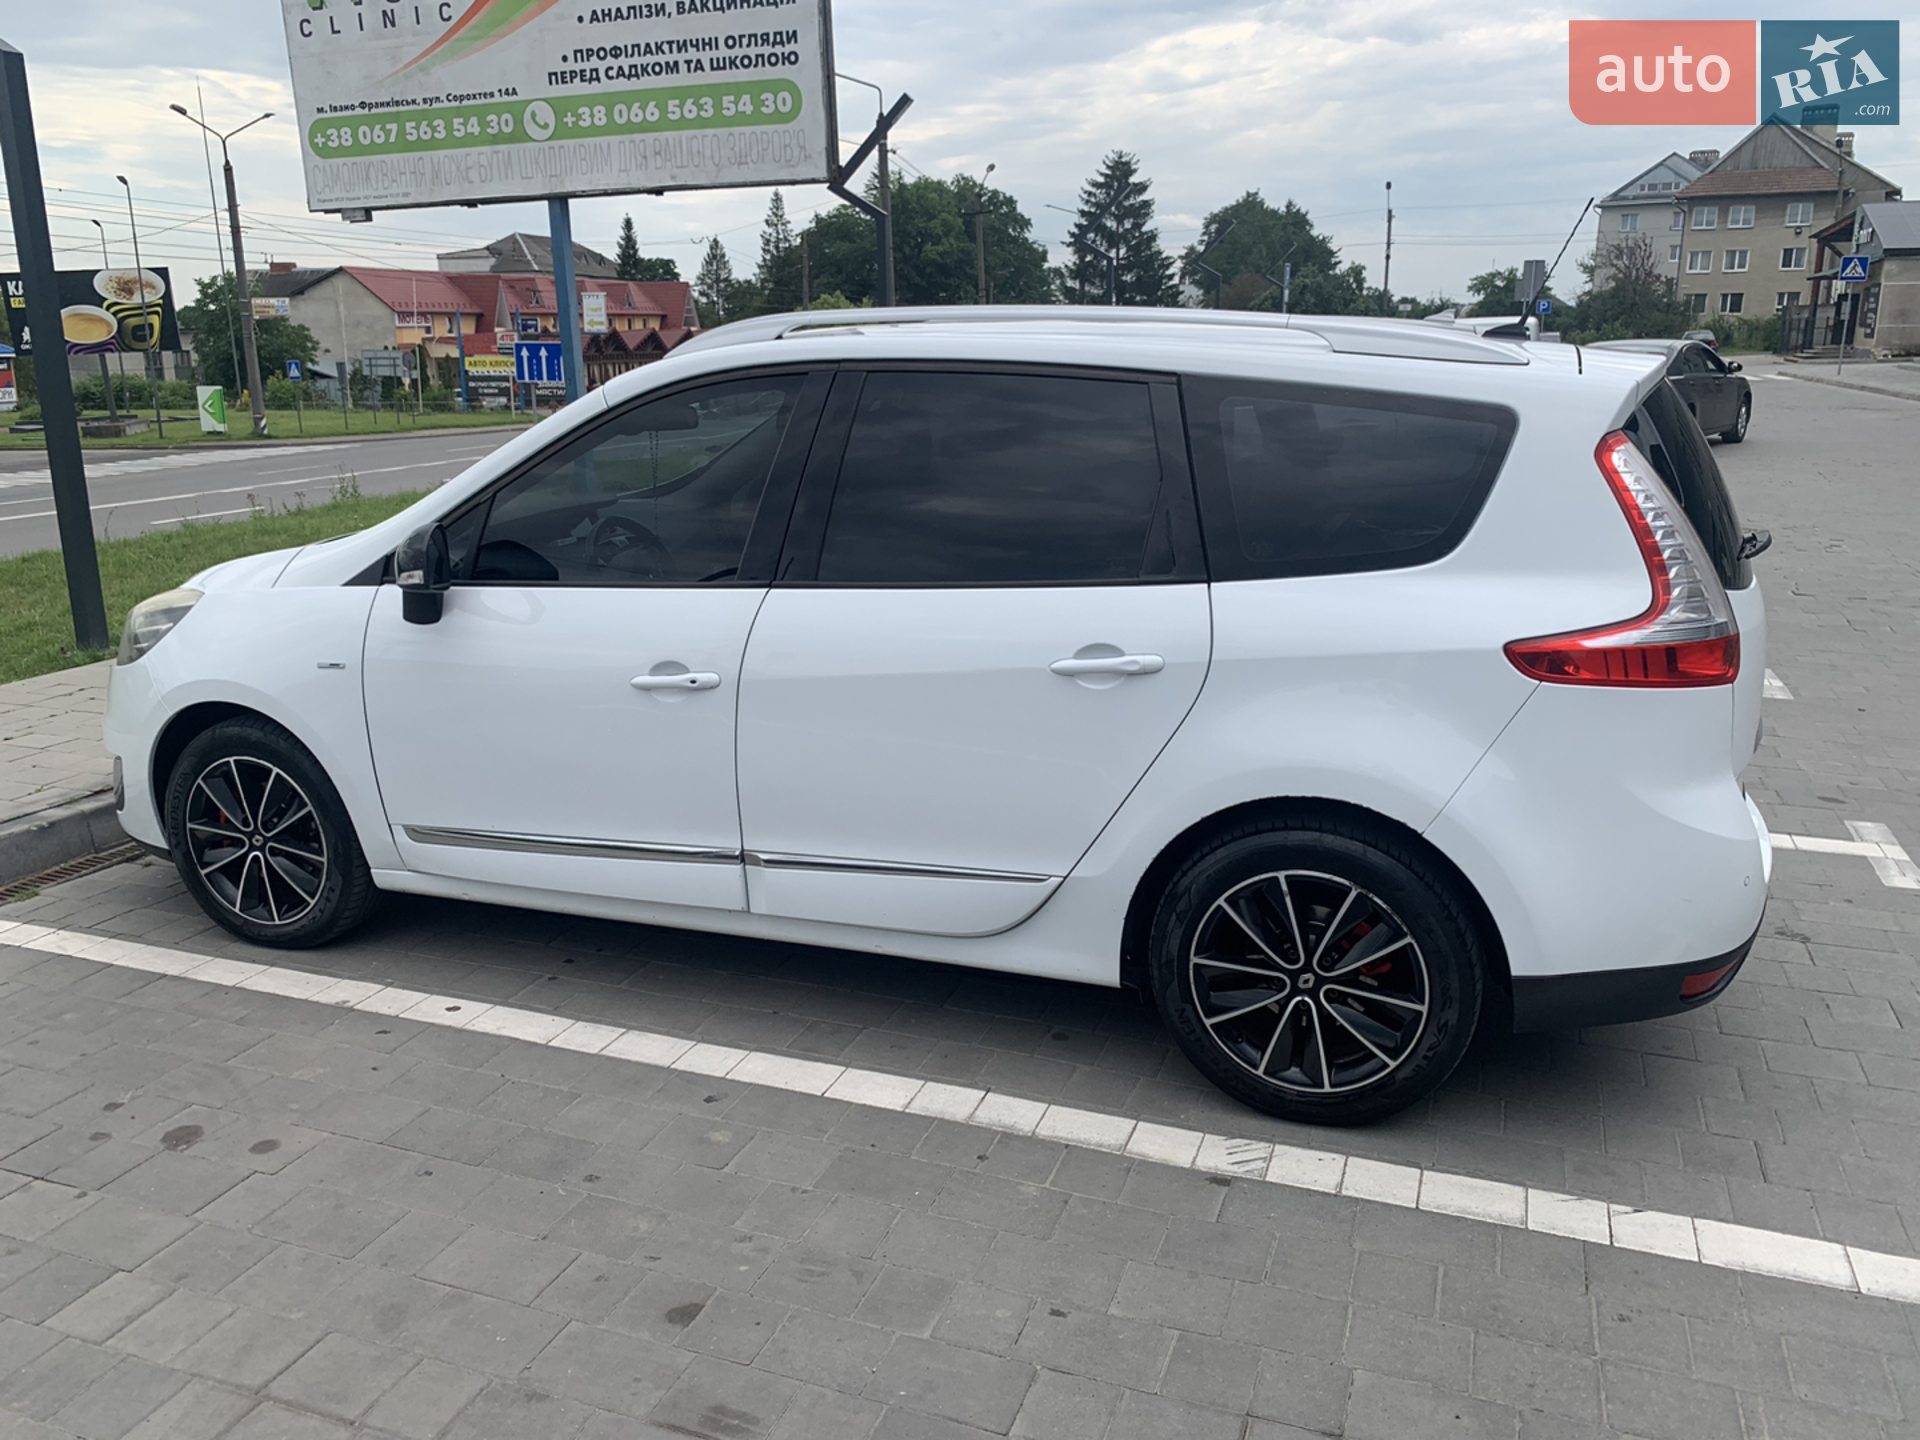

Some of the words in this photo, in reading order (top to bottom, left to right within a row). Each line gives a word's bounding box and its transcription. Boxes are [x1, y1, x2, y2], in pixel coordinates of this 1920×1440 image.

[299, 2, 453, 38] CLINIC
[589, 2, 672, 25] АНАЛІЗИ,
[573, 36, 720, 63] ПРОФІЛАКТИЧНІ
[724, 30, 798, 50] ОГЛЯДИ
[548, 67, 601, 86] ПЕРЕД
[604, 60, 680, 82] САДКОМ
[684, 58, 705, 74] ТА
[710, 51, 800, 71] ШКОЛОЮ
[316, 106, 328, 115] м.
[329, 96, 421, 113] Івано-Франківськ,
[422, 95, 445, 107] вул.
[563, 105, 607, 128] +38
[613, 100, 660, 125] 066
[667, 97, 714, 120] 563
[721, 94, 754, 117] 54
[760, 91, 793, 115] 30
[313, 127, 354, 148] +38
[358, 122, 398, 146] 067
[405, 118, 446, 142] 563
[452, 116, 481, 138] 54
[486, 112, 515, 135] 30
[312, 157, 427, 195] САМОЛІКУВАННЯ
[430, 152, 475, 187] МОЖЕ
[477, 149, 515, 182] БУТИ
[517, 142, 613, 182] ШКІДЛИВИМ
[617, 139, 648, 175] ДЛЯ
[653, 134, 722, 170] ВАШОГО
[398, 314, 431, 324] МОТЕЛЬ
[468, 360, 487, 368] АВТО
